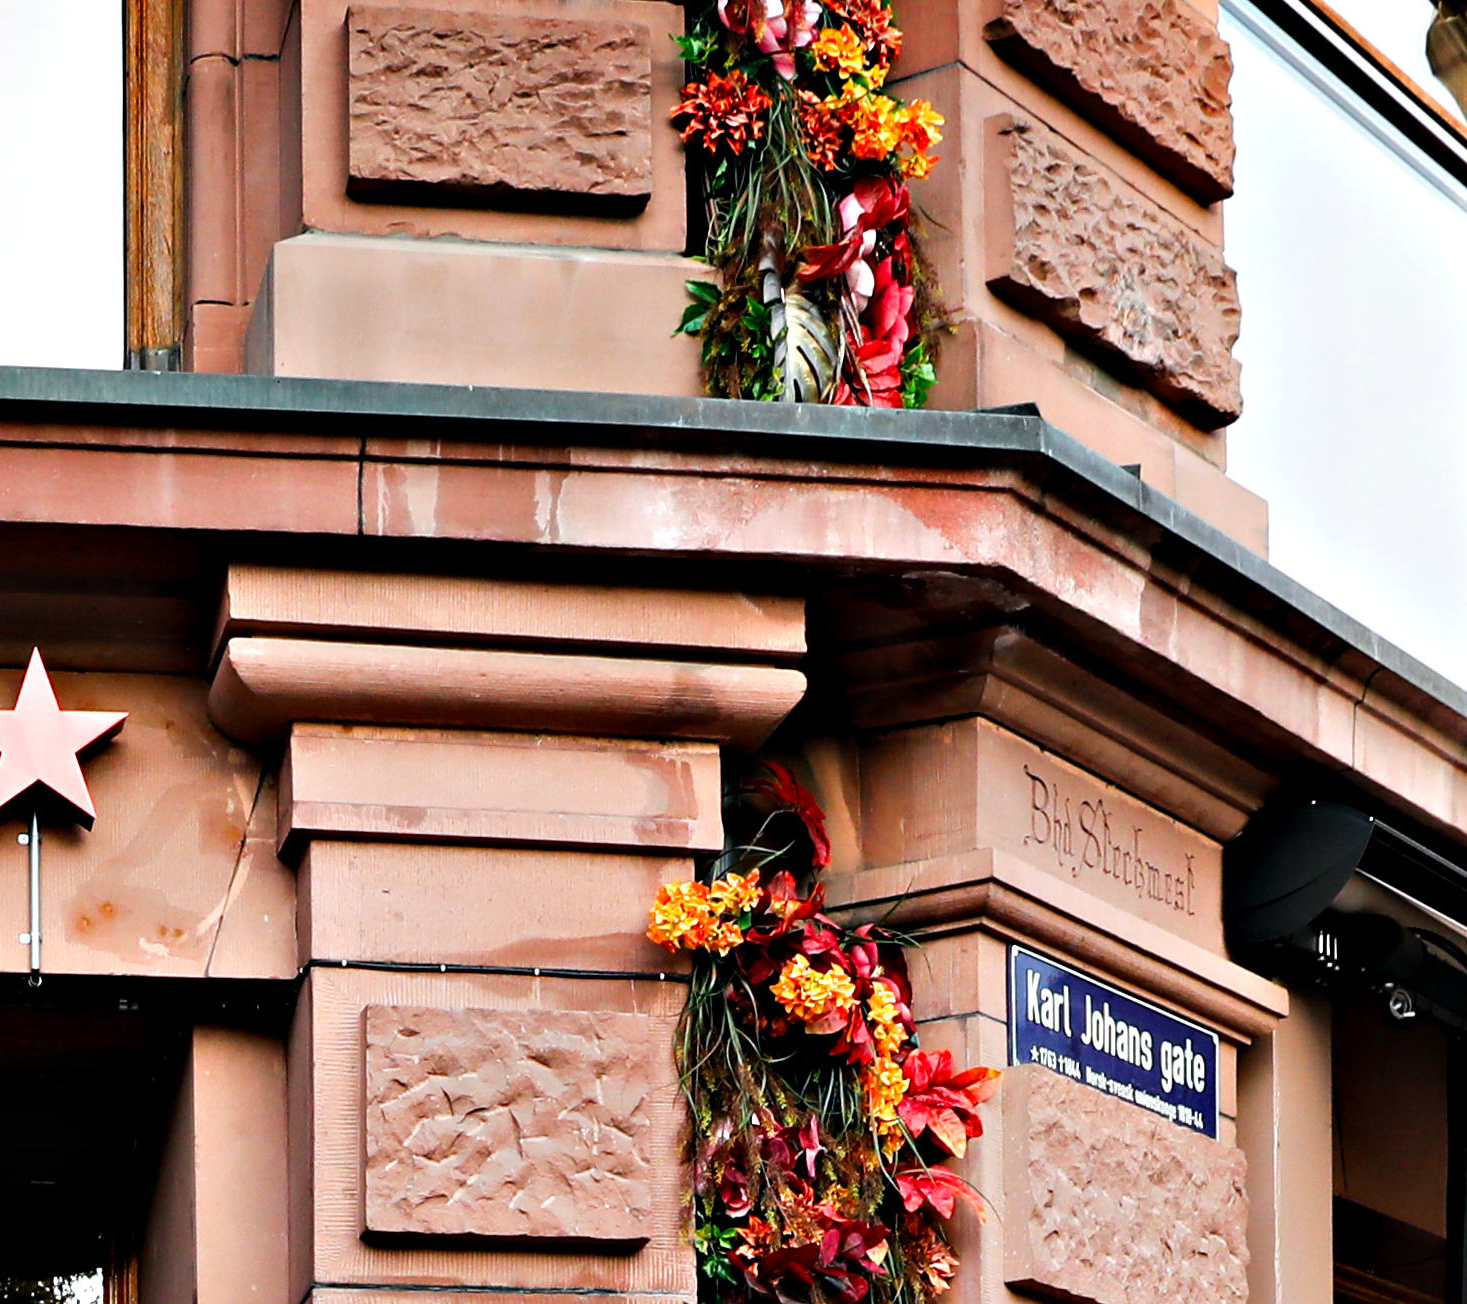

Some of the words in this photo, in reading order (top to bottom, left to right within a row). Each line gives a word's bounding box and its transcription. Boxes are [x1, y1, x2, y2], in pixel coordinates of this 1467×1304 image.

[1027, 969, 1072, 1037] Karl
[1081, 995, 1153, 1070] Johans
[1160, 1038, 1206, 1093] gate
